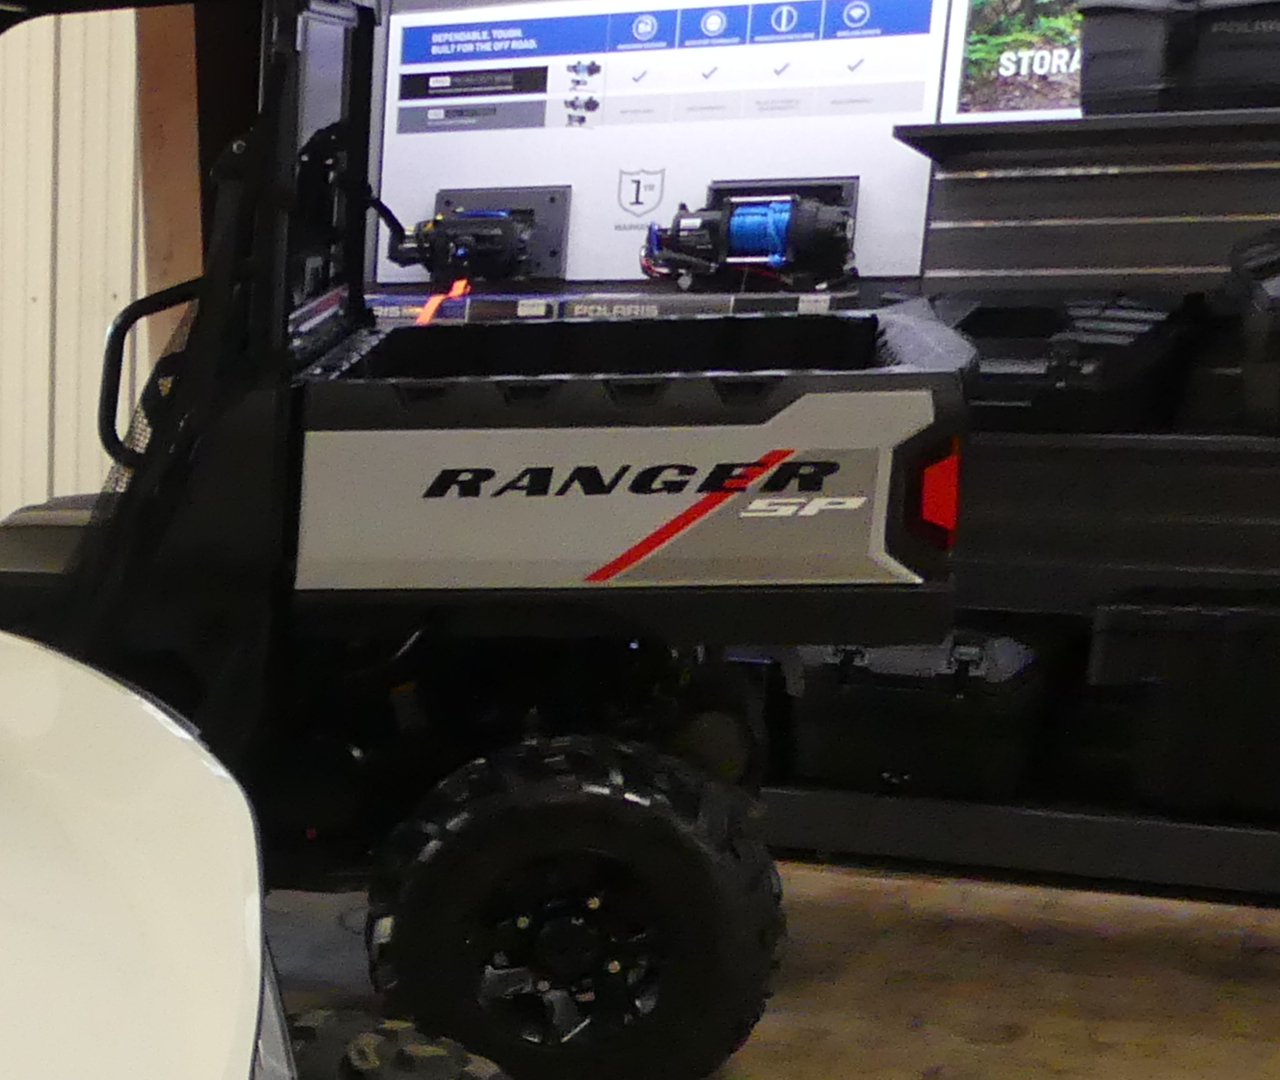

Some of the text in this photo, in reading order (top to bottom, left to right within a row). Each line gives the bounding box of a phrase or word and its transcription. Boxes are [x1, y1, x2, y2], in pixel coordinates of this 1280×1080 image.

[573, 304, 659, 318] POLARIS
[421, 460, 839, 499] RANGER
[739, 497, 868, 518] SP
